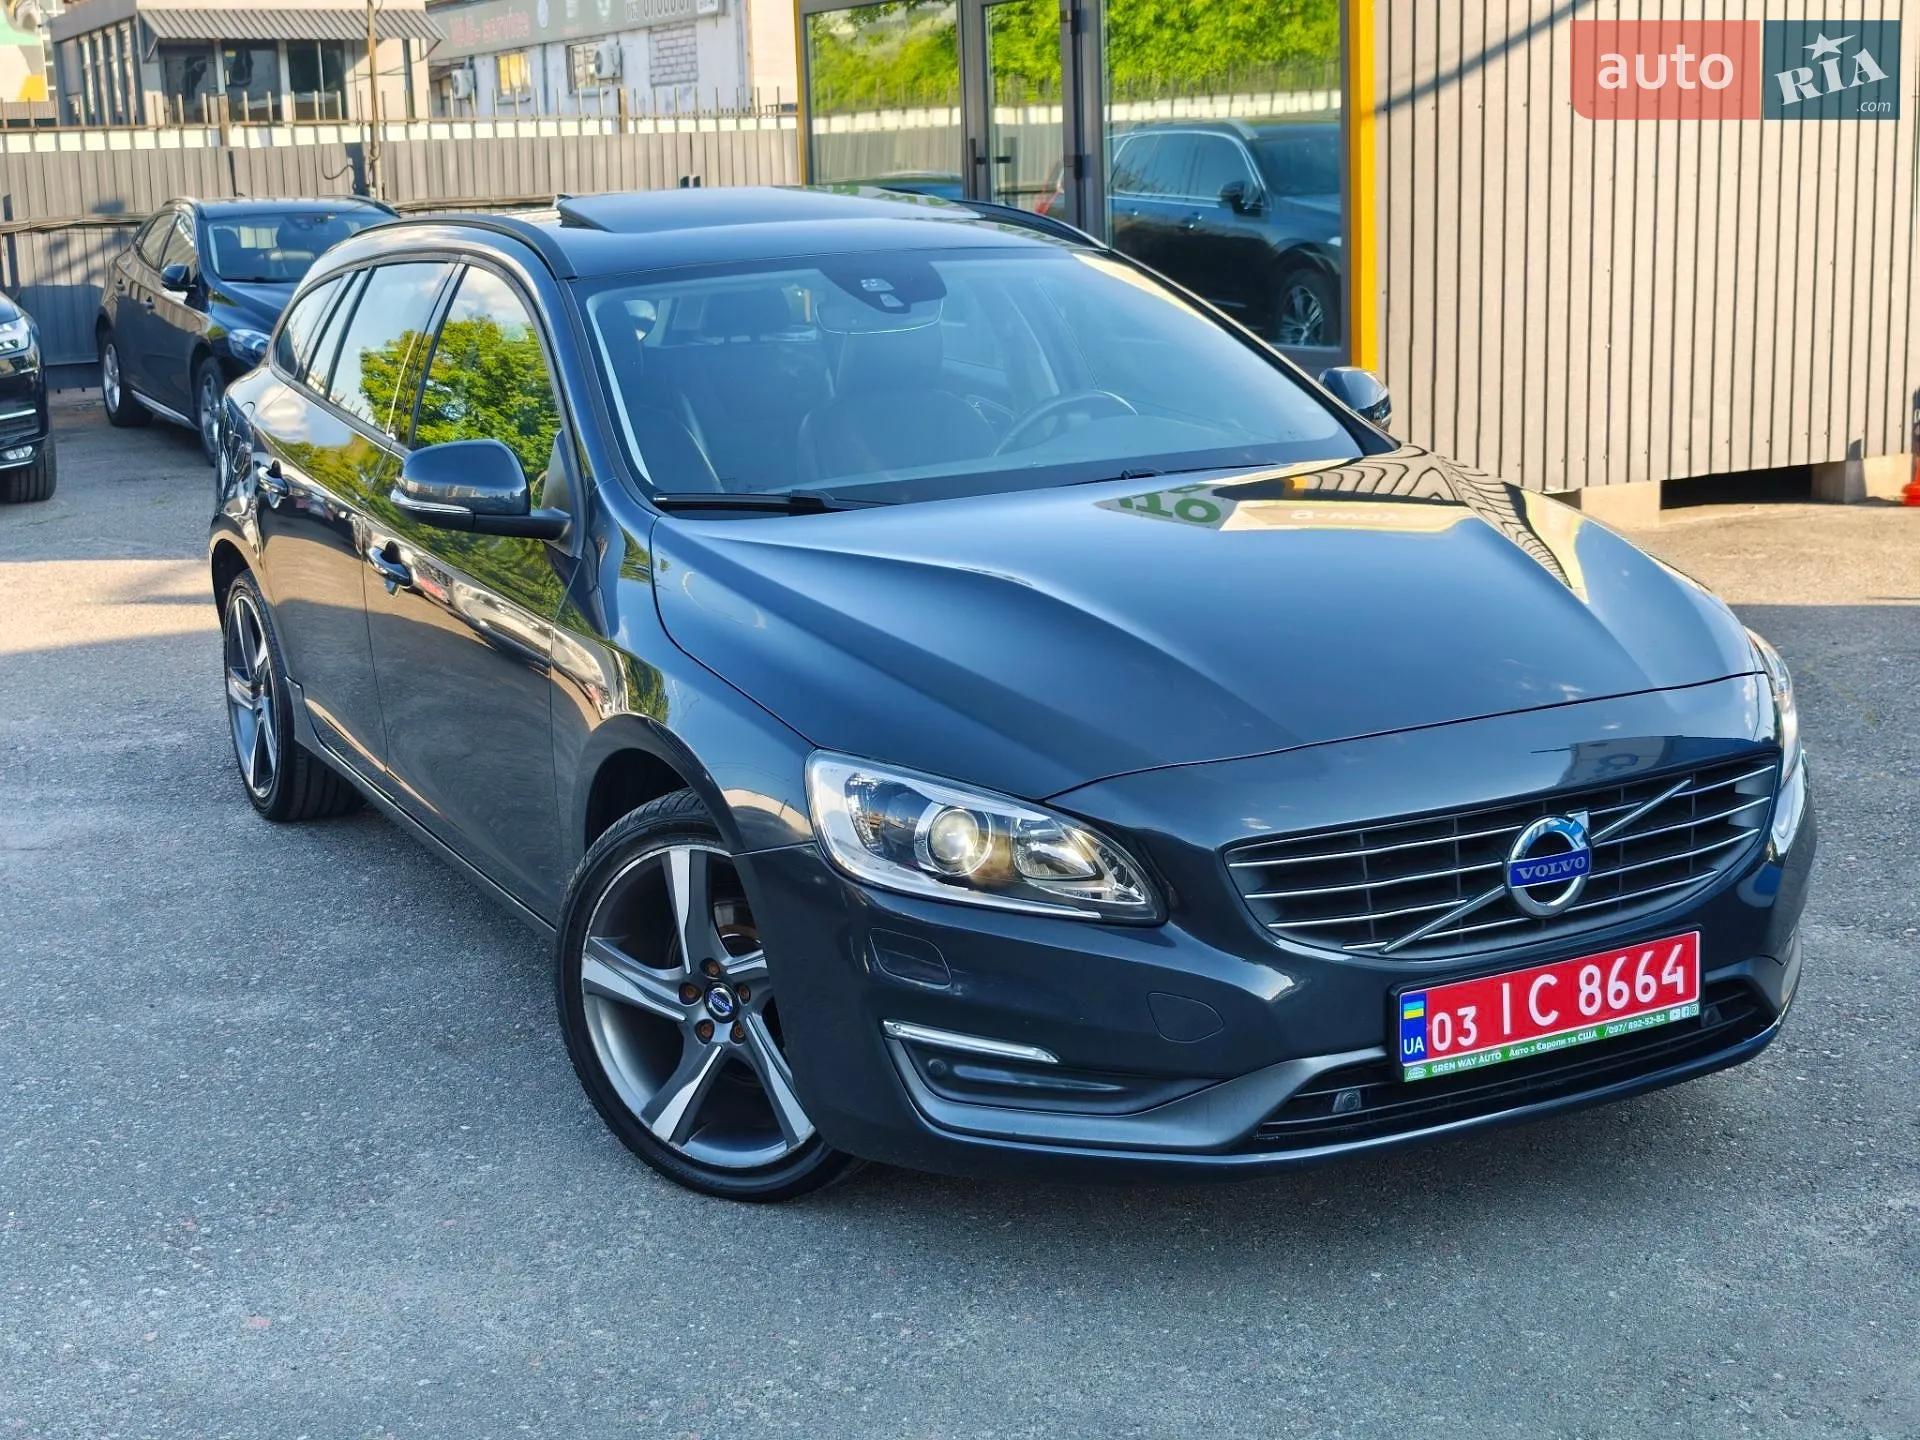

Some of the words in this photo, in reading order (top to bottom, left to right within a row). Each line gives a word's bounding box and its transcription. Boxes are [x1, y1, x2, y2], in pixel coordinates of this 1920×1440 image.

[1516, 856, 1586, 880] VOLVO
[1431, 1005, 1478, 1052] 03
[1577, 943, 1685, 1016] 8664
[1403, 1036, 1425, 1055] UA
[1509, 1046, 1529, 1058] Авто
[1577, 1030, 1598, 1042] США
[1431, 1062, 1456, 1074] GREN
[1457, 1057, 1478, 1069] WAY
[1478, 1051, 1502, 1064] AUTO
